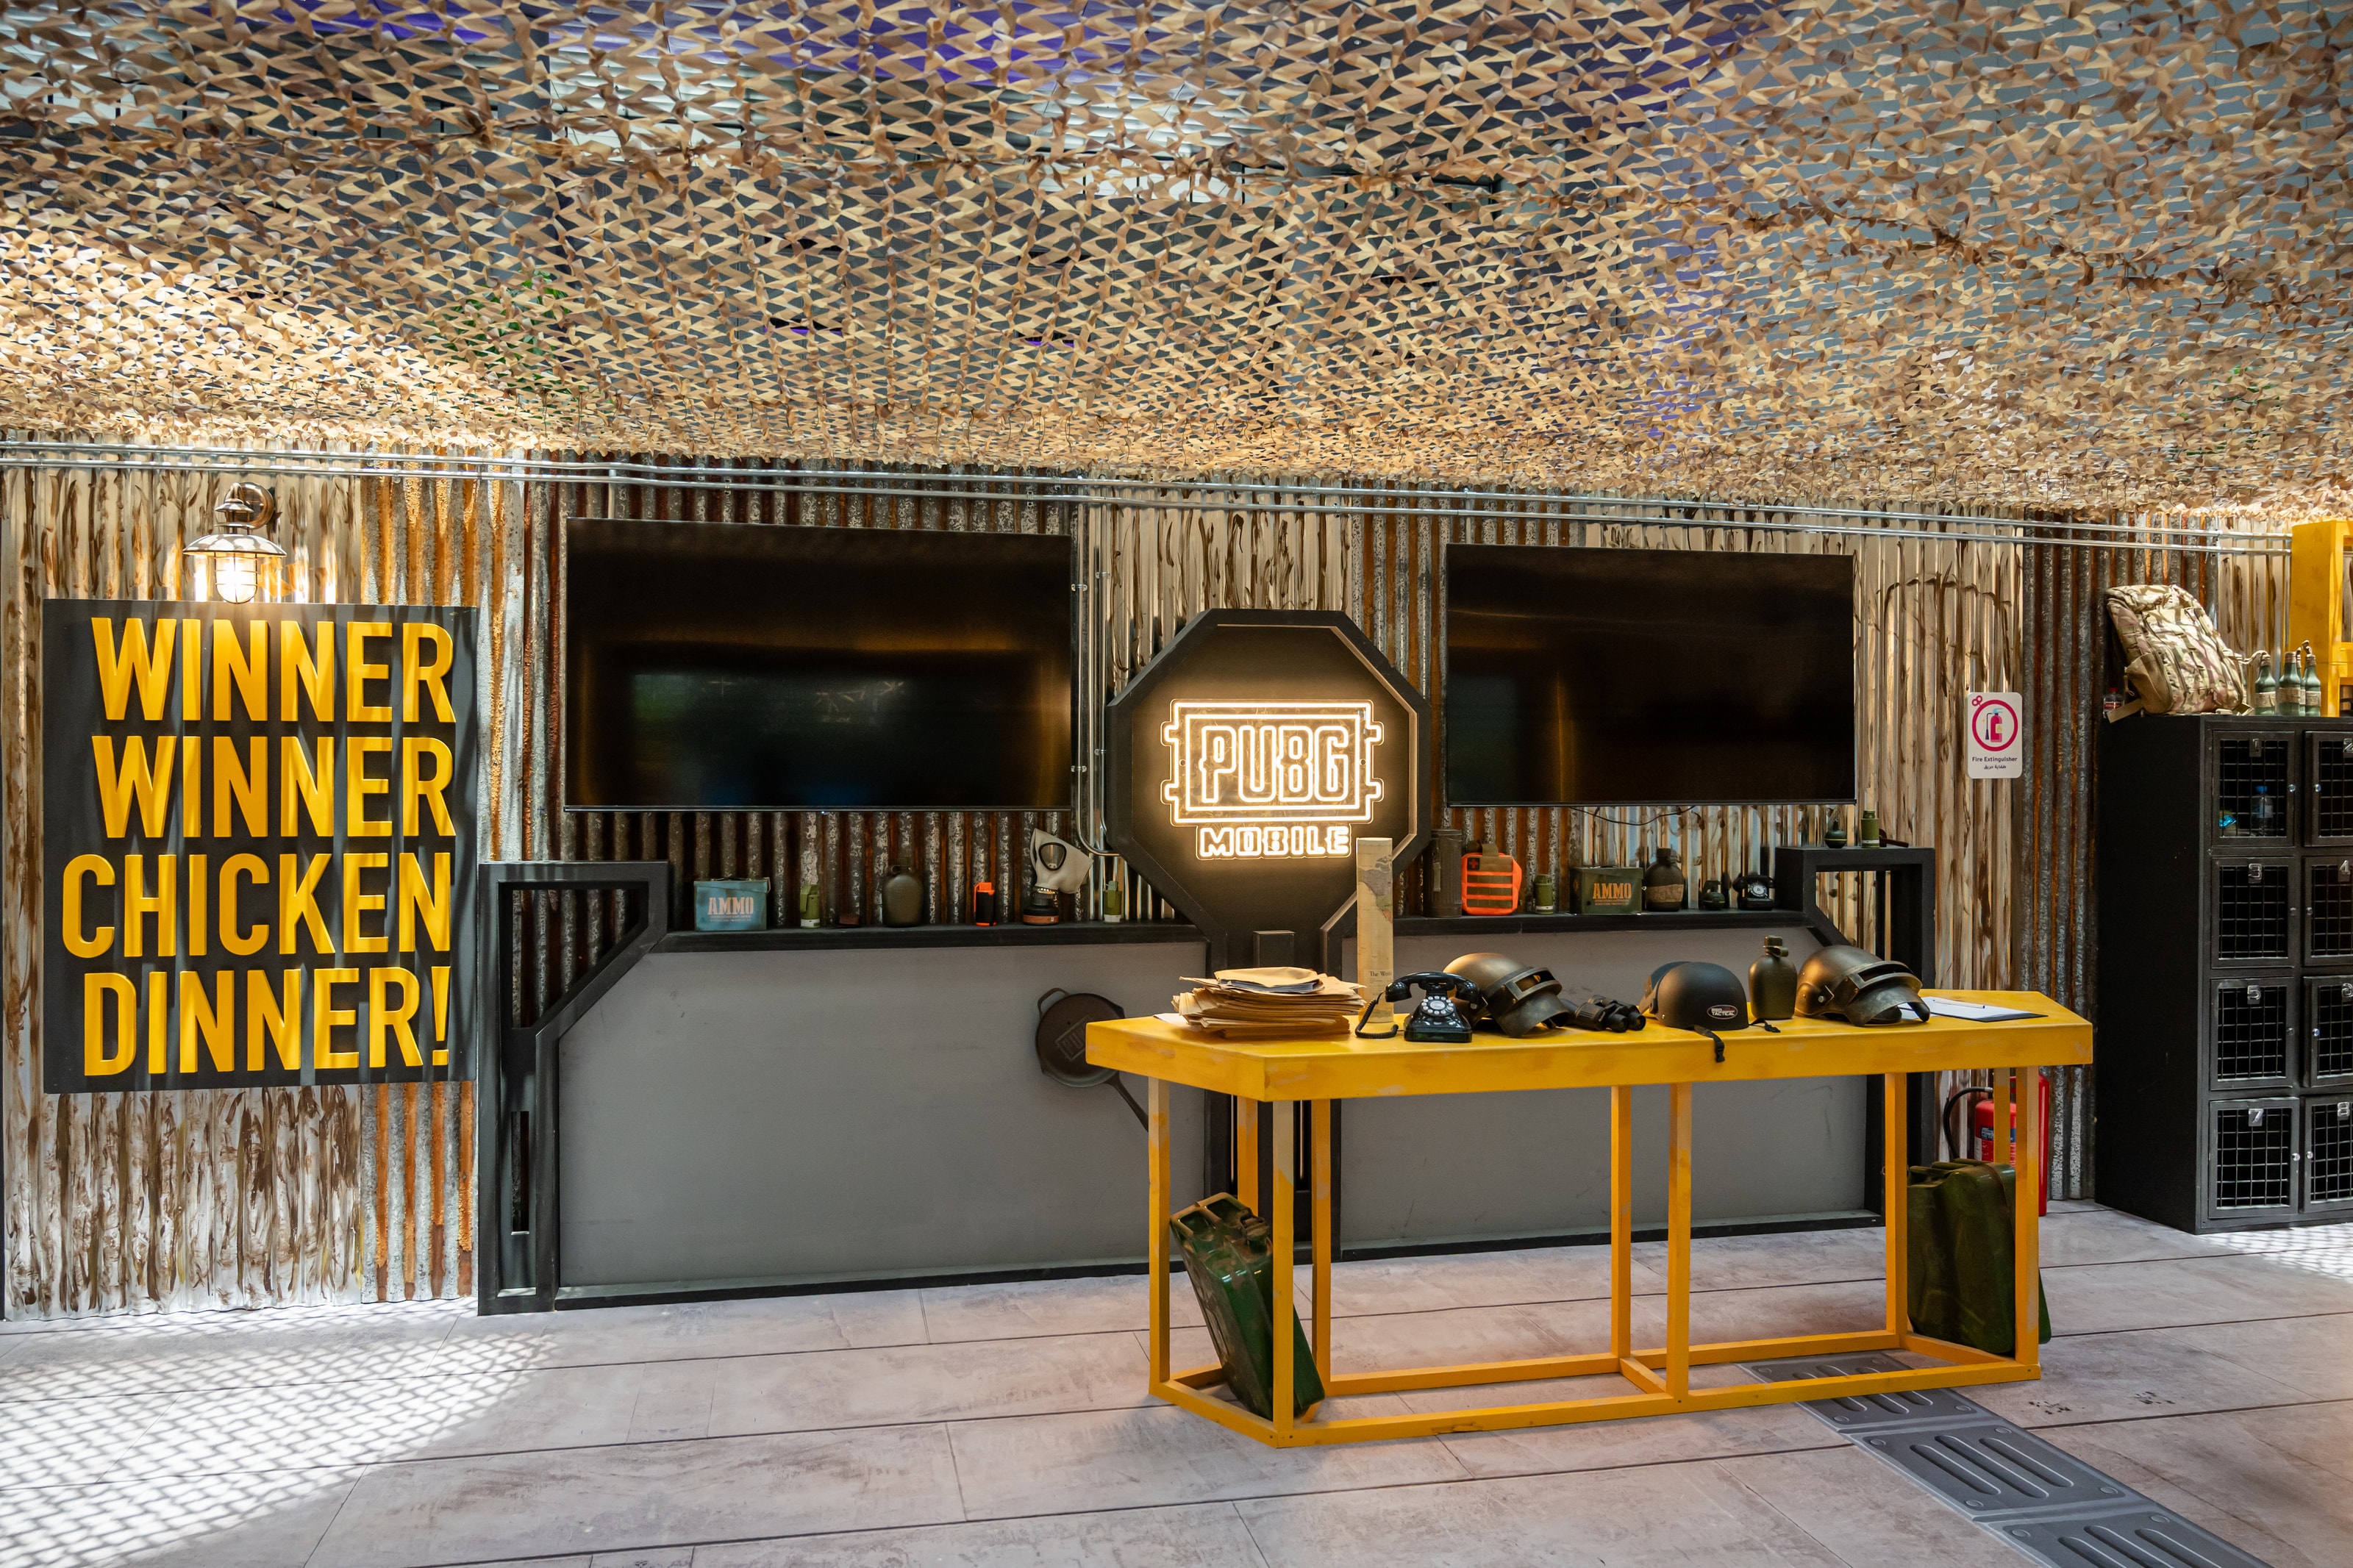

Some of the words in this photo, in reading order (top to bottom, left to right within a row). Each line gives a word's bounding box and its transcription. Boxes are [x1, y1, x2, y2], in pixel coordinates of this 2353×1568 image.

[91, 617, 457, 723] WINNER
[1199, 725, 1349, 803] PUBG
[91, 735, 457, 838] WINNER
[1199, 826, 1349, 856] MOBILE
[2248, 863, 2263, 880] 3
[2339, 859, 2351, 875] 4
[1592, 883, 1632, 900] AMMO
[62, 852, 451, 959] CHICKEN
[707, 897, 754, 915] AMMO
[2247, 985, 2261, 1000] 5
[84, 966, 451, 1076] DINNER!
[2249, 1108, 2264, 1123] 7
[2337, 1101, 2350, 1117] 8
